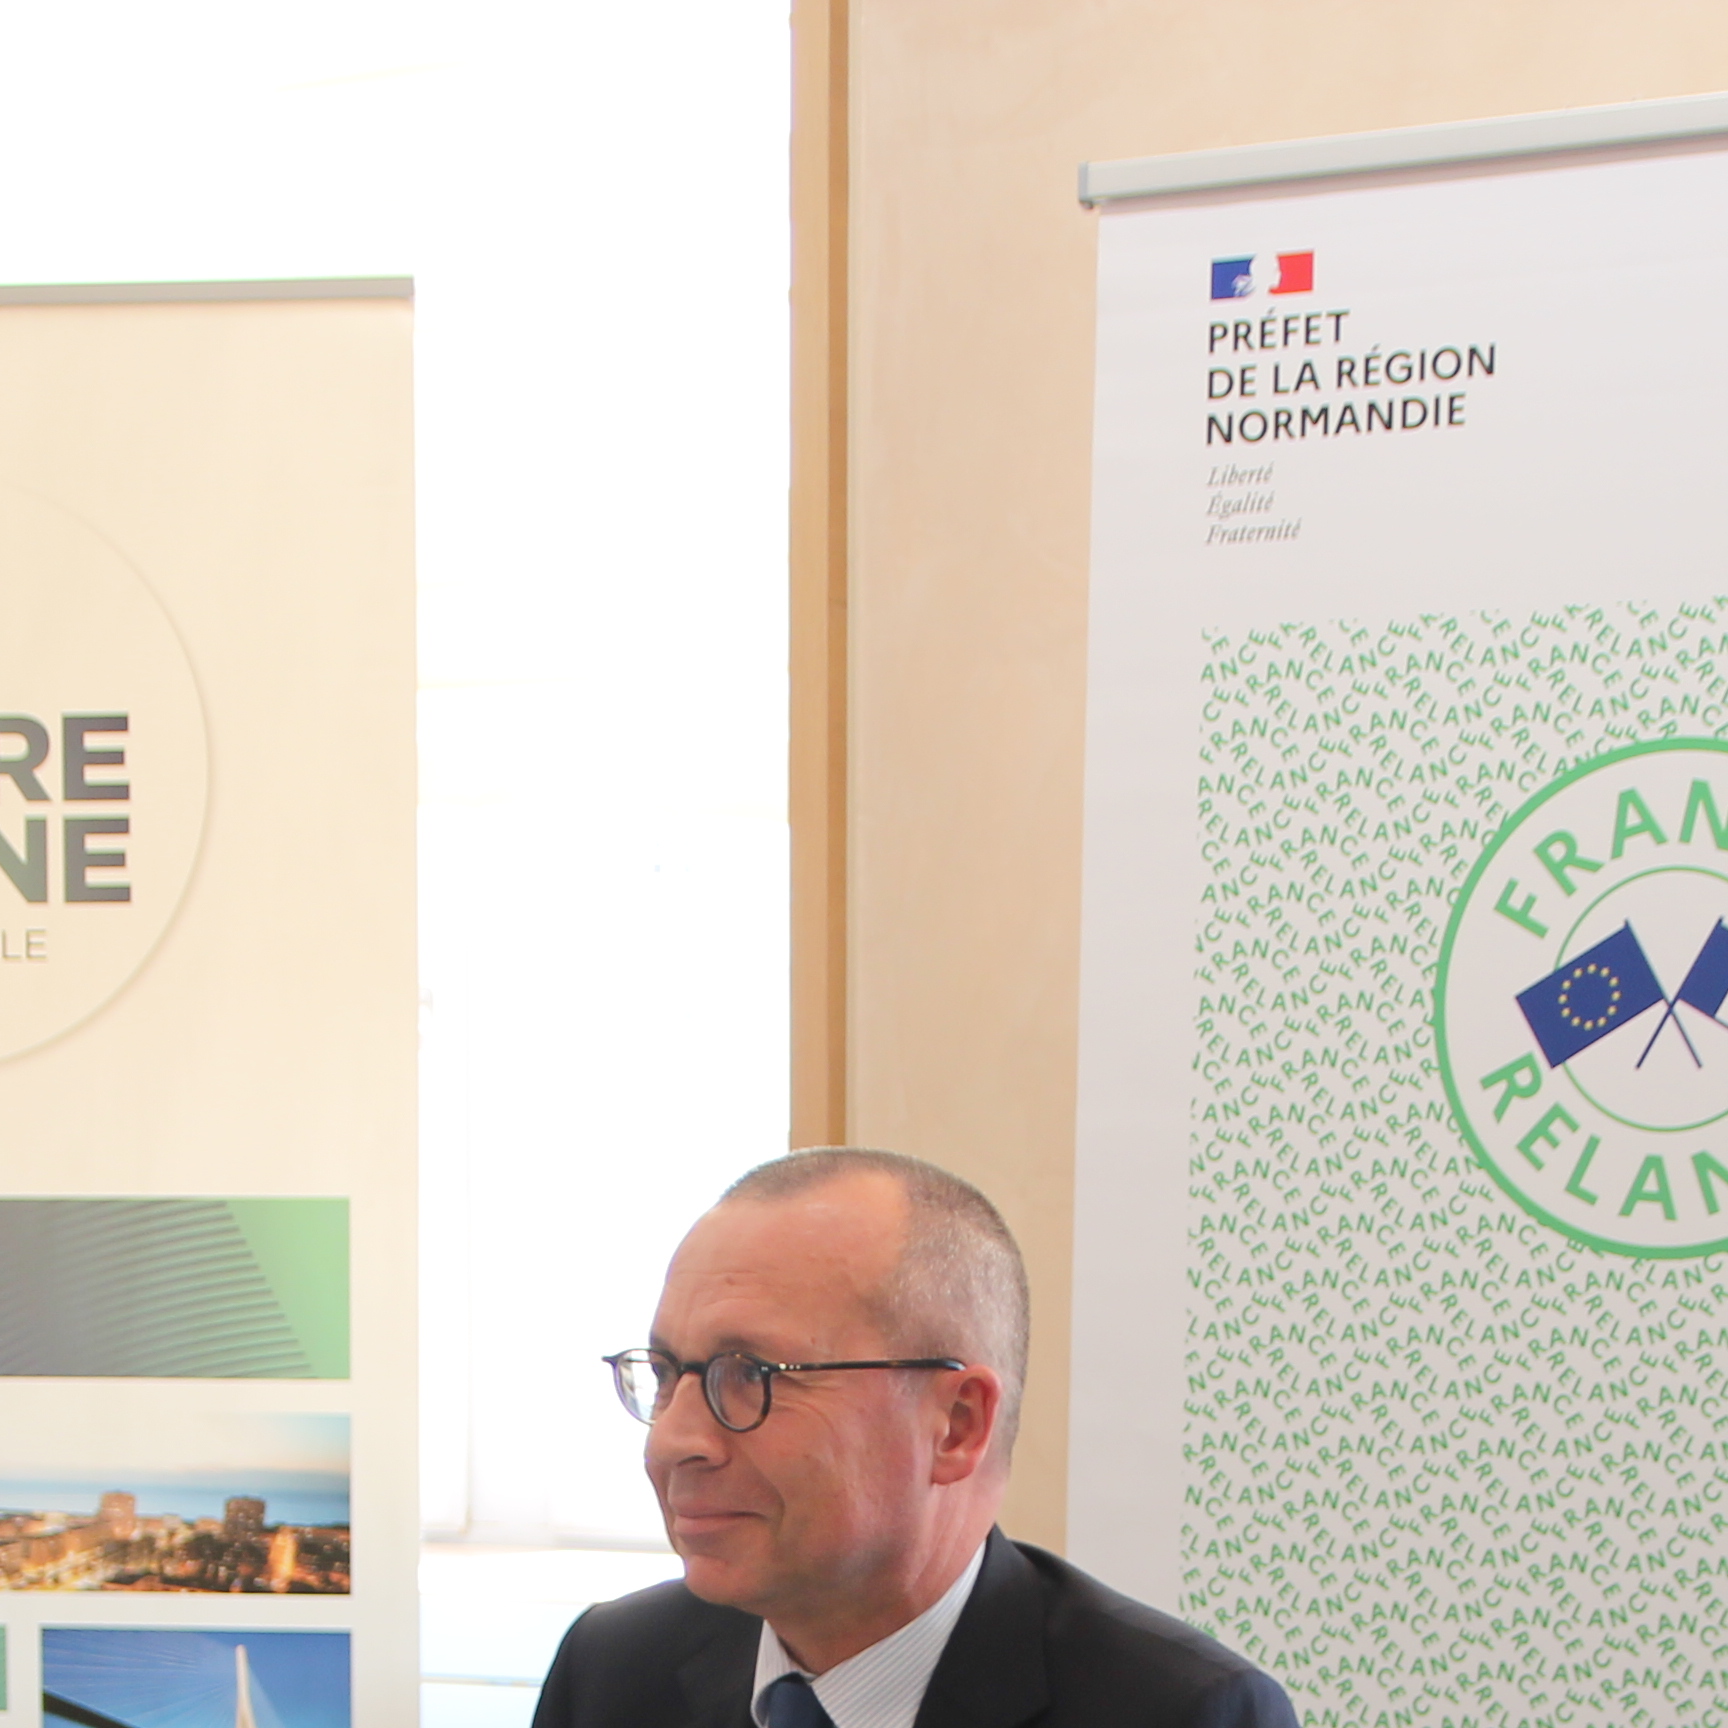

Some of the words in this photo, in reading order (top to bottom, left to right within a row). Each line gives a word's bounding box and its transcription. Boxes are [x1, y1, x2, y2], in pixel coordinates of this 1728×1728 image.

[1208, 307, 1351, 354] PRÉFET
[1208, 363, 1258, 400] DE
[1272, 358, 1321, 394] LA
[1336, 343, 1497, 389] RÉGION
[1206, 390, 1468, 446] NORMANDIE
[1206, 461, 1275, 487] Liberté
[1205, 490, 1275, 519] Égalité
[1204, 517, 1303, 546] Fraternité
[1234, 657, 1336, 708] FRANCE
[1372, 649, 1477, 701] FRANCE
[1515, 641, 1623, 693] FRANCE
[1546, 662, 1659, 719] RELANCE
[1264, 678, 1370, 733] RELANCE
[1403, 670, 1512, 726] RELANCE
[1303, 765, 1406, 816] FRANCE
[1333, 787, 1441, 842] RELANCE
[1235, 880, 1337, 929] FRANCE
[1265, 902, 1370, 956] RELANCE
[1304, 989, 1407, 1038] FRANCE
[1334, 1012, 1441, 1066] RELANCE
[1236, 1101, 1337, 1150] FRANCE
[1265, 1125, 1371, 1177] RELANCE
[1551, 1269, 1659, 1318] FRANCE
[1236, 1322, 1338, 1370] FRANCE
[1583, 1294, 1695, 1347] RELANCE
[1266, 1347, 1371, 1398] RELANCE
[1339, 1379, 1443, 1427] FRANCE
[1370, 1404, 1477, 1456] RELANCE
[1444, 1437, 1550, 1486] FRANCE
[1475, 1462, 1585, 1515] RELANCE
[1551, 1496, 1659, 1545] FRANCE
[1237, 1542, 1338, 1590] FRANCE
[1583, 1521, 1695, 1575] RELANCE
[1267, 1566, 1372, 1618] RELANCE
[1340, 1601, 1443, 1650] FRANCE
[1370, 1625, 1477, 1678] RELANCE
[1445, 1661, 1550, 1710] FRANCE
